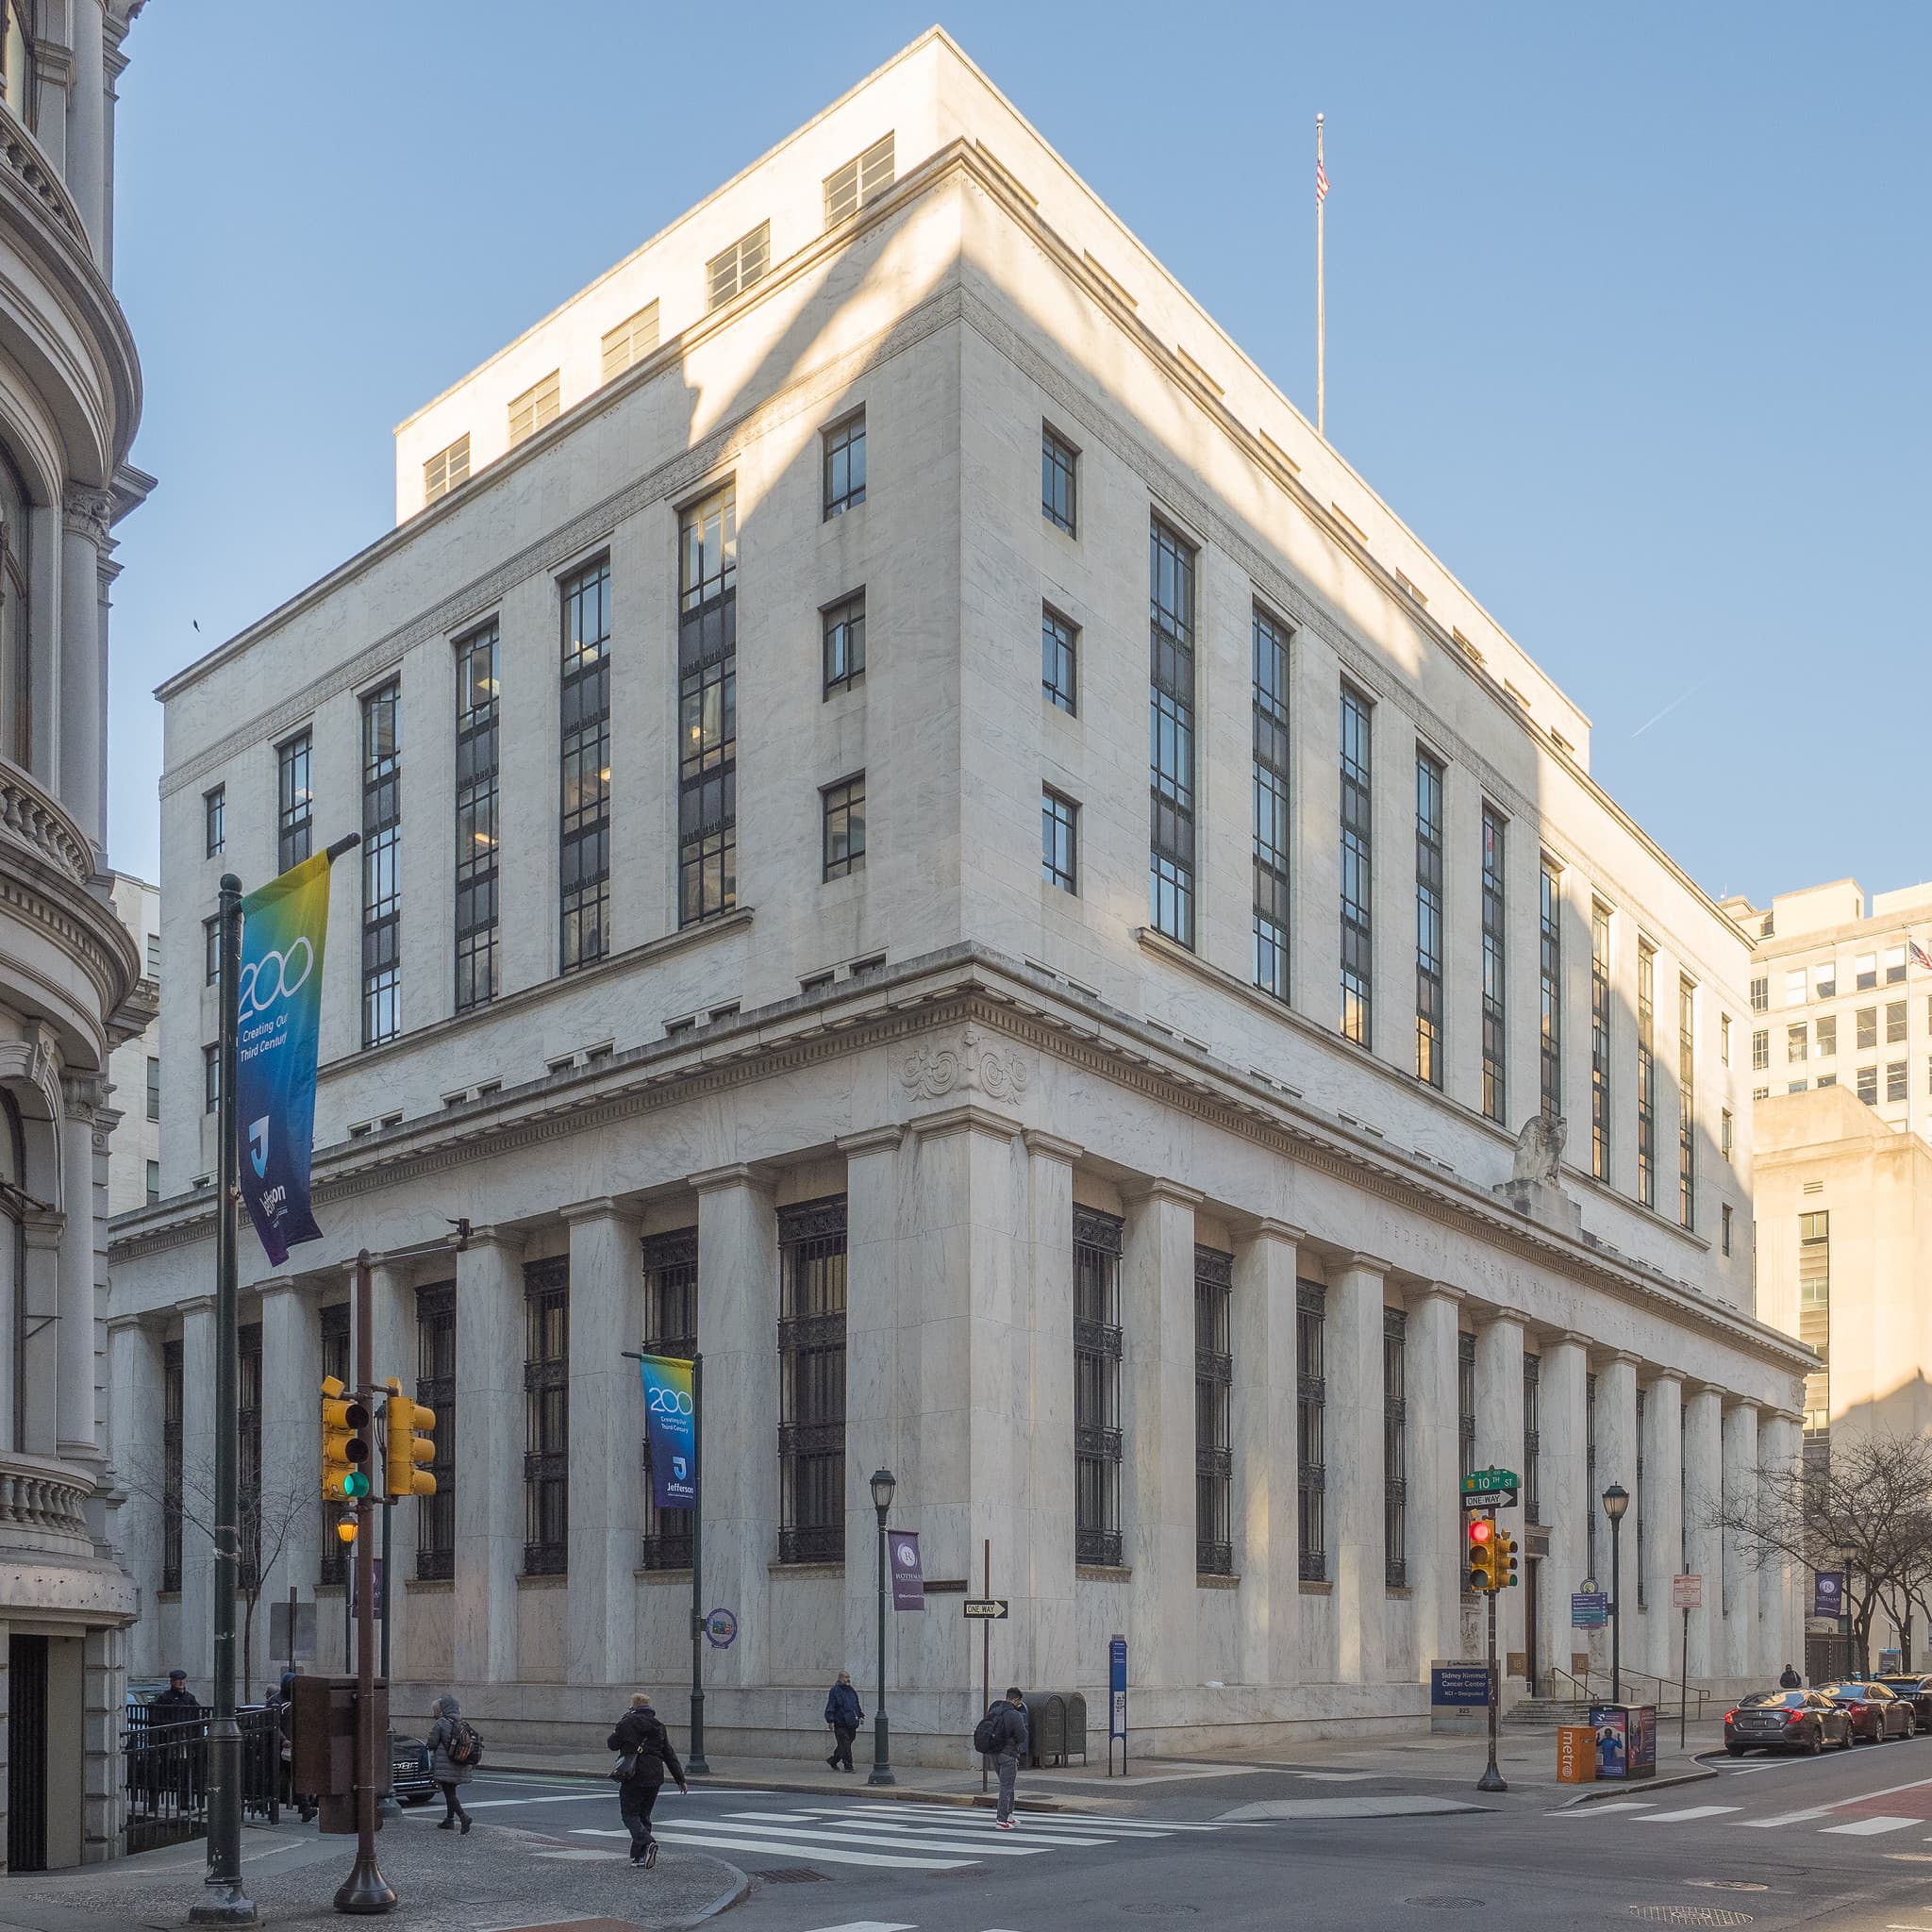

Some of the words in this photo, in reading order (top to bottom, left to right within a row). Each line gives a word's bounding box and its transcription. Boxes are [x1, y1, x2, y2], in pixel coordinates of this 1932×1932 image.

[239, 936, 314, 1025] 200
[242, 1022, 275, 1042] Creating
[275, 1012, 289, 1028] Our
[241, 1043, 259, 1062] Third
[259, 1030, 288, 1053] Century
[648, 1387, 693, 1415] 200
[667, 1482, 694, 1494] Jefferson
[1504, 1478, 1512, 1488] ST
[1467, 1496, 1483, 1506] ONE
[1484, 1494, 1501, 1504] WAY
[1441, 1672, 1461, 1680] Sidney
